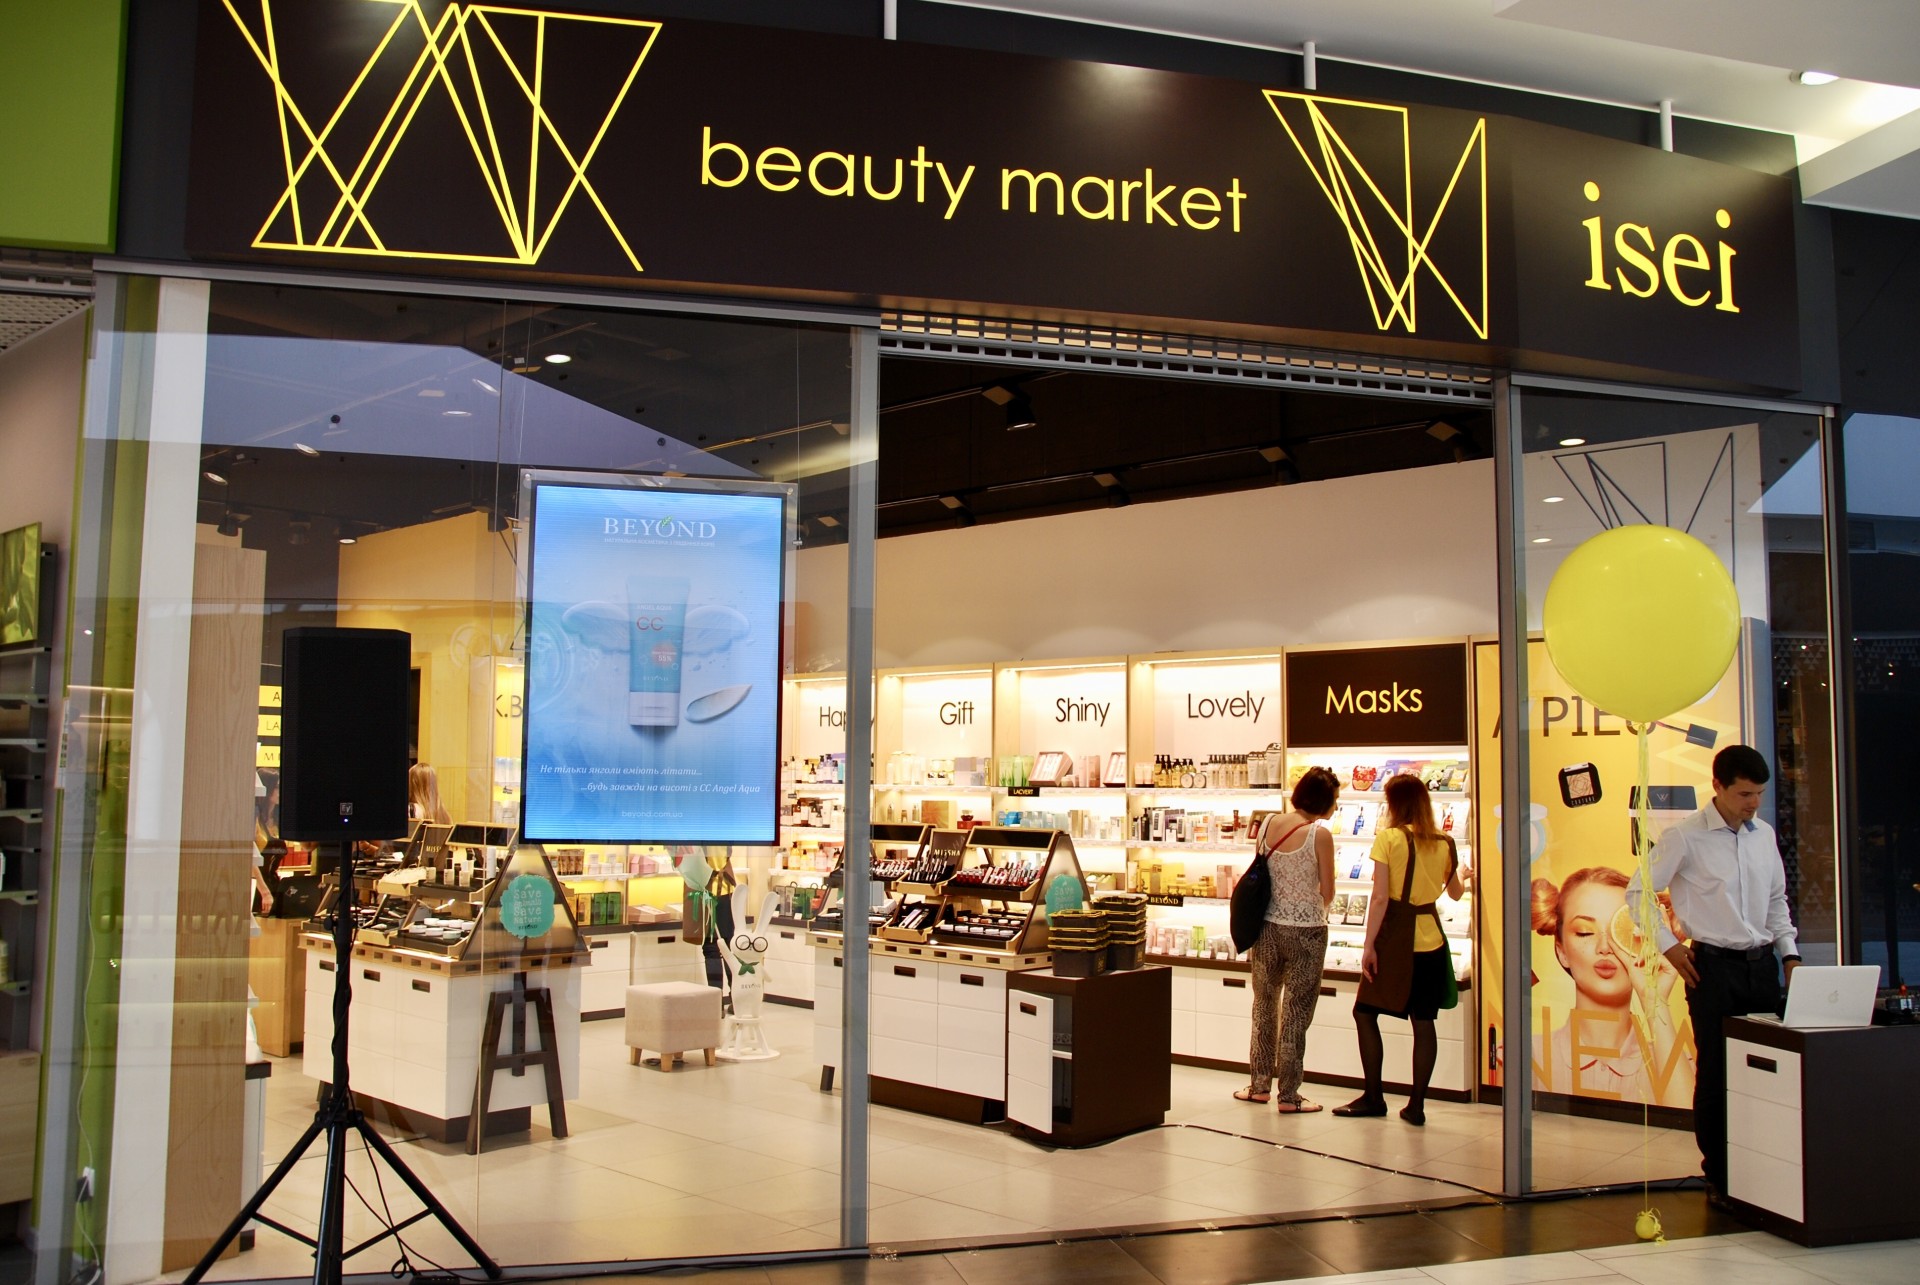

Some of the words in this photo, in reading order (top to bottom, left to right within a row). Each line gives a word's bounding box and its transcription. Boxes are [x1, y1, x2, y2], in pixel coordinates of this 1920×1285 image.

[701, 126, 976, 220] beauty
[1001, 168, 1247, 232] market
[1582, 181, 1740, 313] isei
[603, 516, 717, 539] BEYOND
[636, 616, 664, 631] CC
[1188, 690, 1265, 723] Lovely
[1325, 681, 1423, 715] Masks
[939, 701, 975, 725] Gift
[1055, 697, 1110, 727] Shiny
[540, 764, 552, 774] Не
[554, 764, 587, 774] тільки
[588, 766, 621, 775] янголи
[623, 766, 659, 775] вміють
[610, 782, 645, 792] завжди
[646, 784, 658, 792] на
[660, 783, 691, 792] висоті
[712, 783, 737, 795] Angel
[738, 783, 761, 795] Aqua
[621, 810, 684, 819] beyond.com.ua
[513, 888, 542, 899] Save
[1150, 896, 1179, 905] BEYOND
[513, 906, 542, 917] Save
